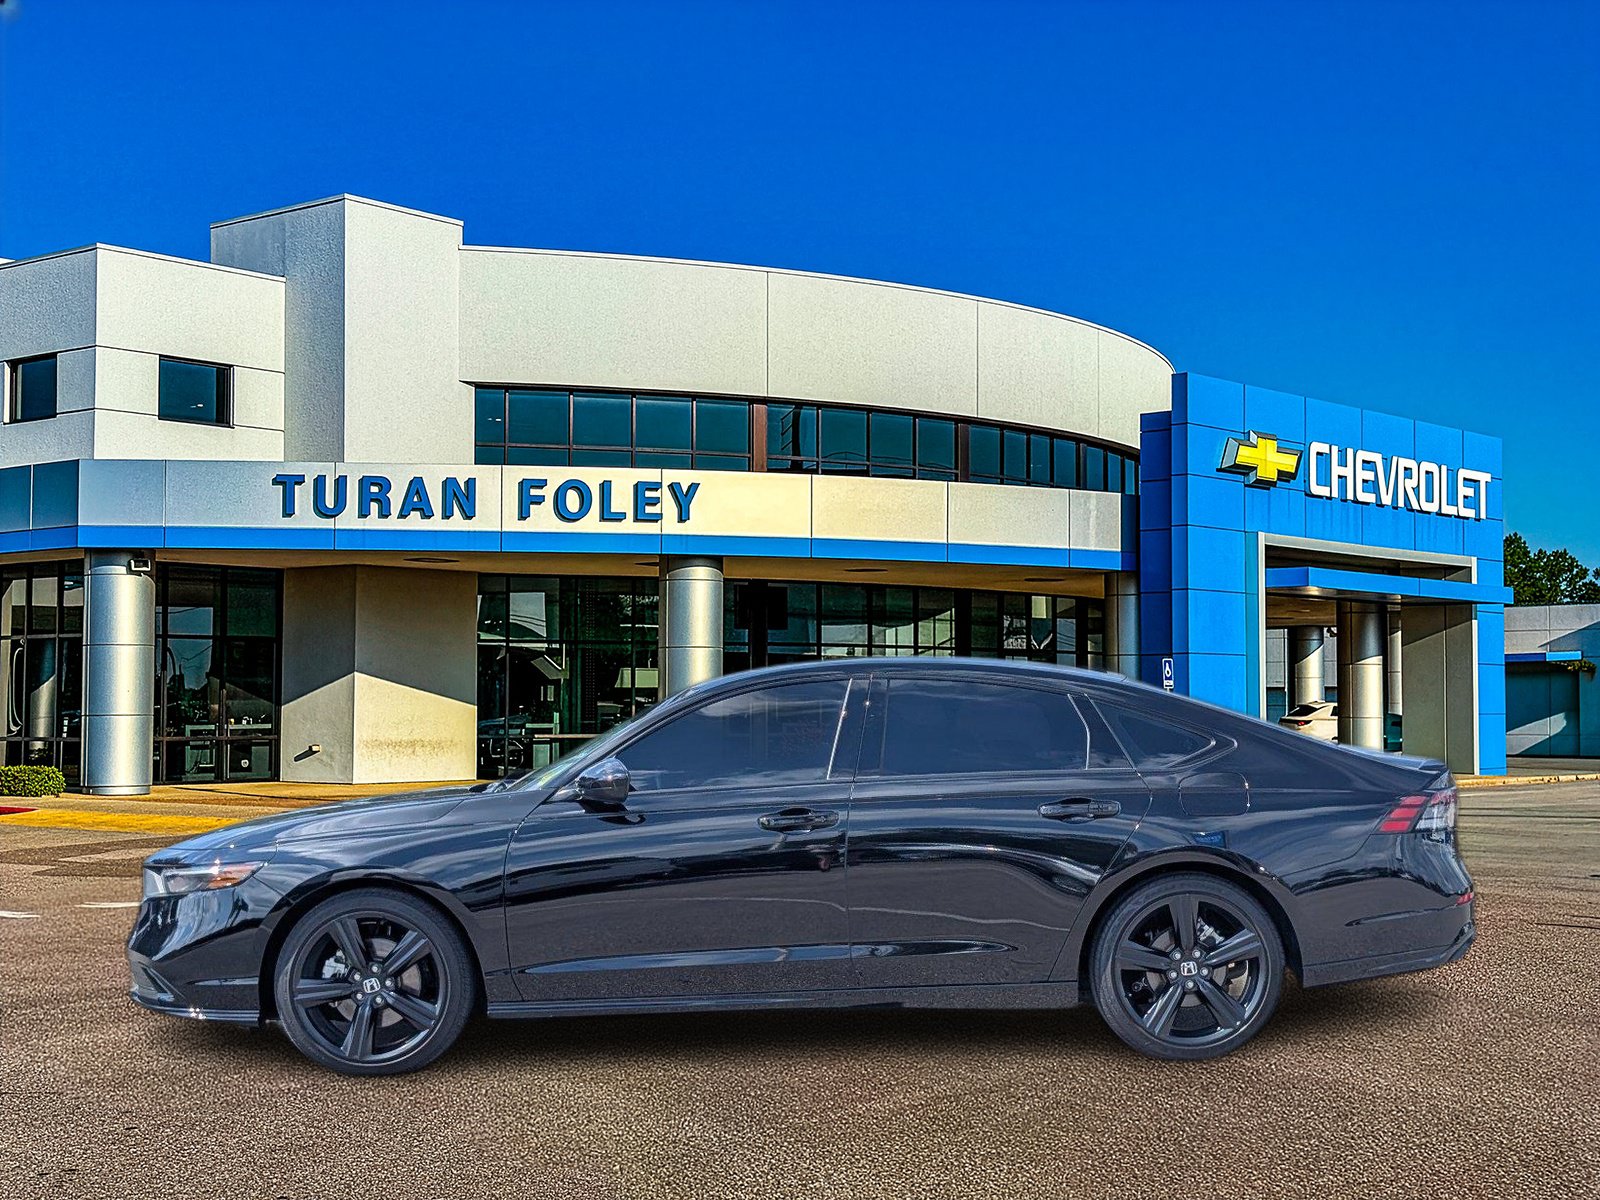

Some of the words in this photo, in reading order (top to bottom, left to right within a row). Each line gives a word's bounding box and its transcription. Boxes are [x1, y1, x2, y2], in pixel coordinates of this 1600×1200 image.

[272, 474, 477, 520] TURAN
[518, 479, 700, 523] FOLEY
[1309, 441, 1492, 520] CHEVROLET
